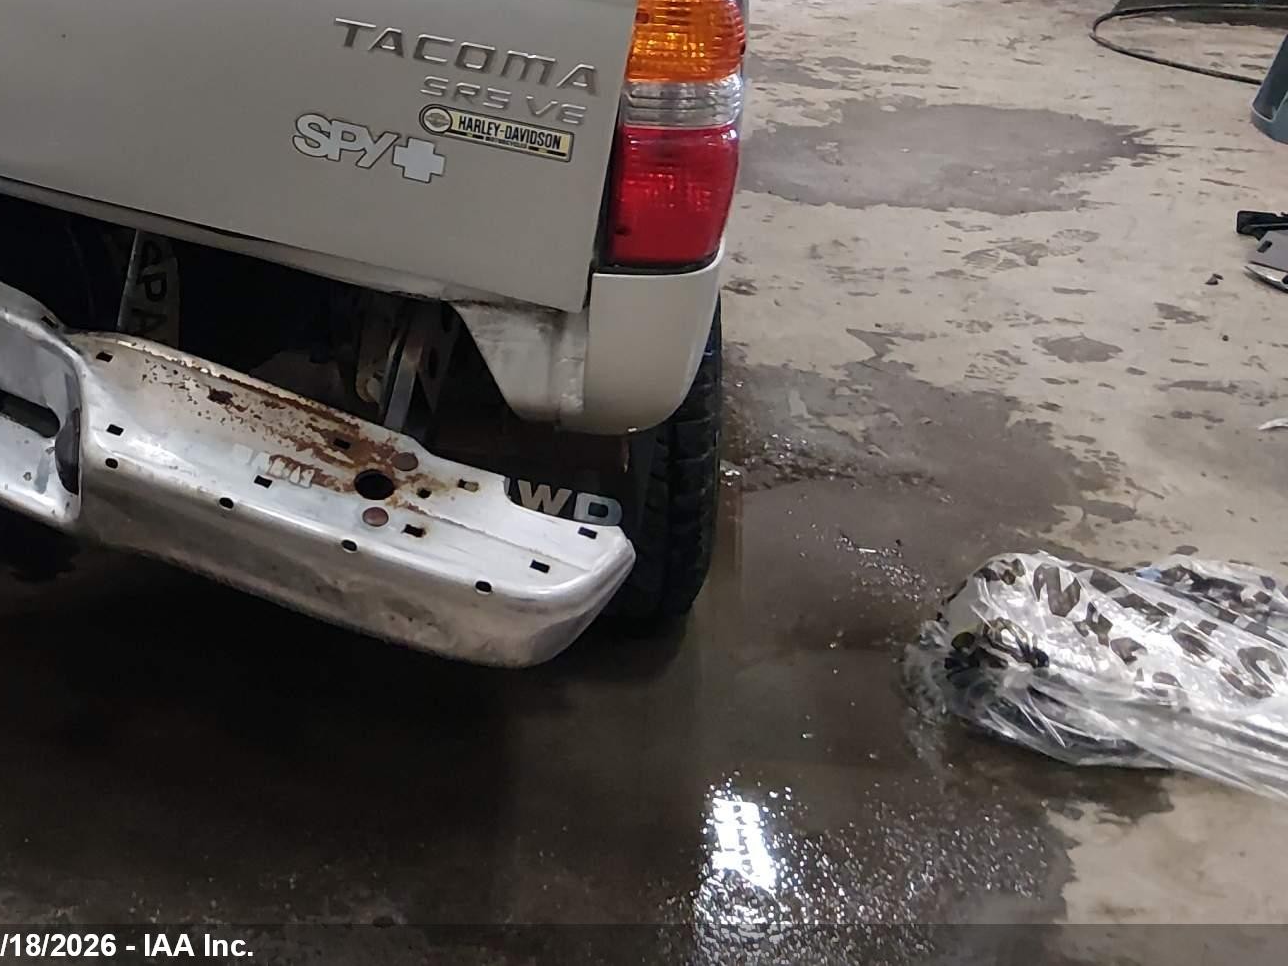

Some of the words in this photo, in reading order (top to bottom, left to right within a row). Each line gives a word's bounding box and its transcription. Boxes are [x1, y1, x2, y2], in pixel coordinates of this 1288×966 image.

[335, 17, 598, 95] TACOMA
[420, 75, 512, 110] SR5
[525, 95, 588, 125] V6
[458, 114, 562, 150] HARLEY-DAVIDSON
[504, 476, 623, 526] WD
